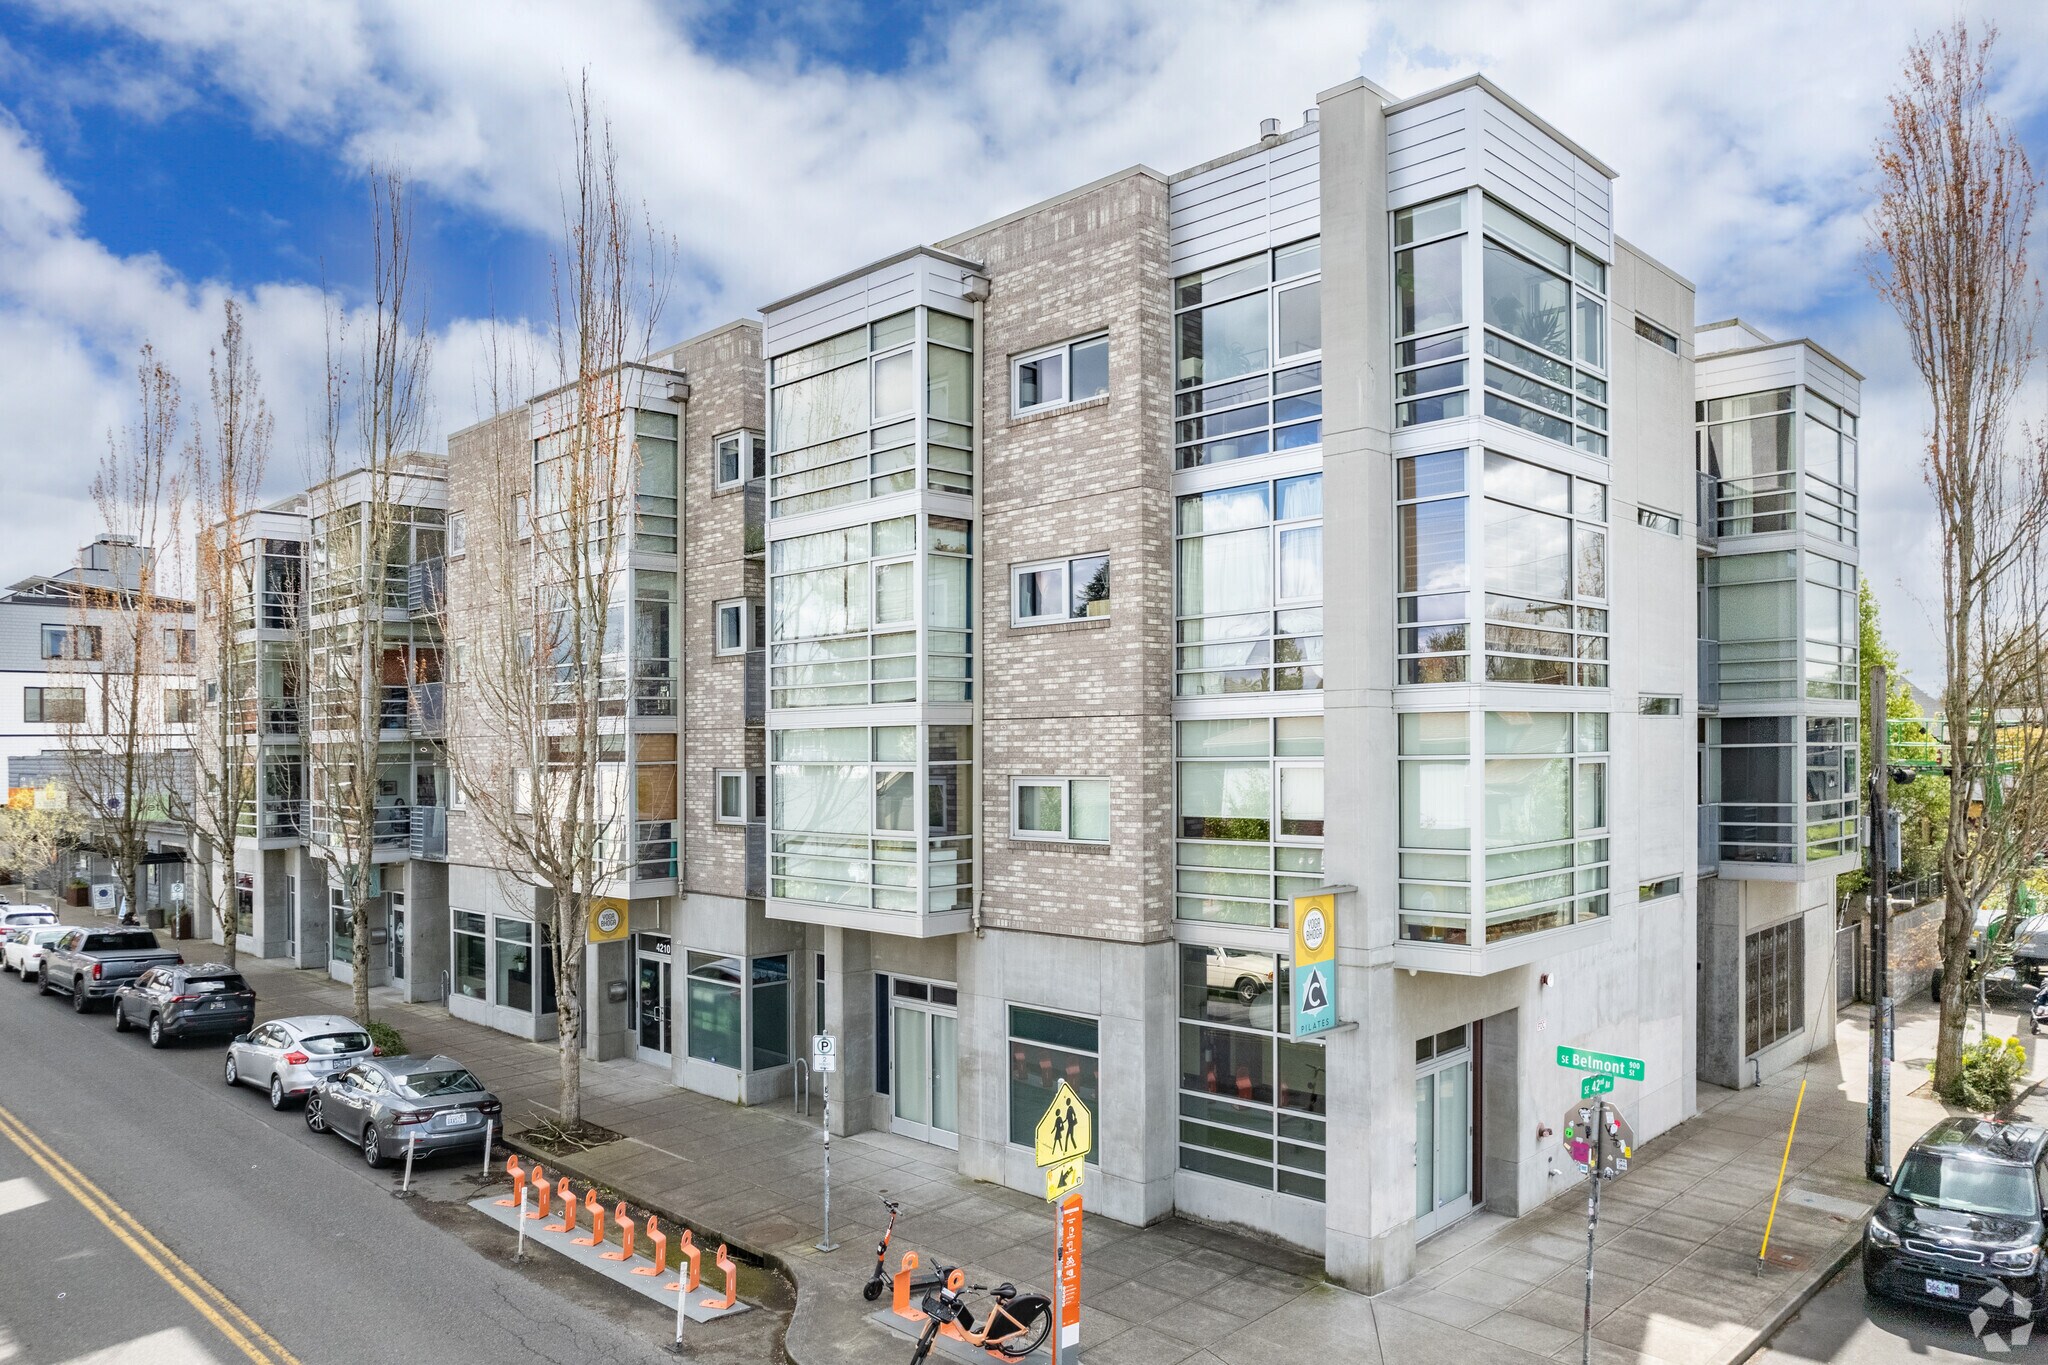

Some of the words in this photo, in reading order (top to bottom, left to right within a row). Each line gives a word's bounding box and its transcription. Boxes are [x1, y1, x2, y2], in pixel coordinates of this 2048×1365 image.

[601, 919, 617, 927] BHOGA
[1307, 917, 1321, 930] YOGA
[1306, 929, 1322, 941] BHOGA
[656, 943, 671, 954] 4210
[1308, 982, 1321, 1007] C
[1301, 1018, 1330, 1033] PILATES
[821, 1041, 829, 1051] P
[1561, 1055, 1569, 1064] SE
[1572, 1053, 1625, 1075] Belmont
[1584, 1085, 1590, 1094] SE
[1927, 1281, 1941, 1292] 566
